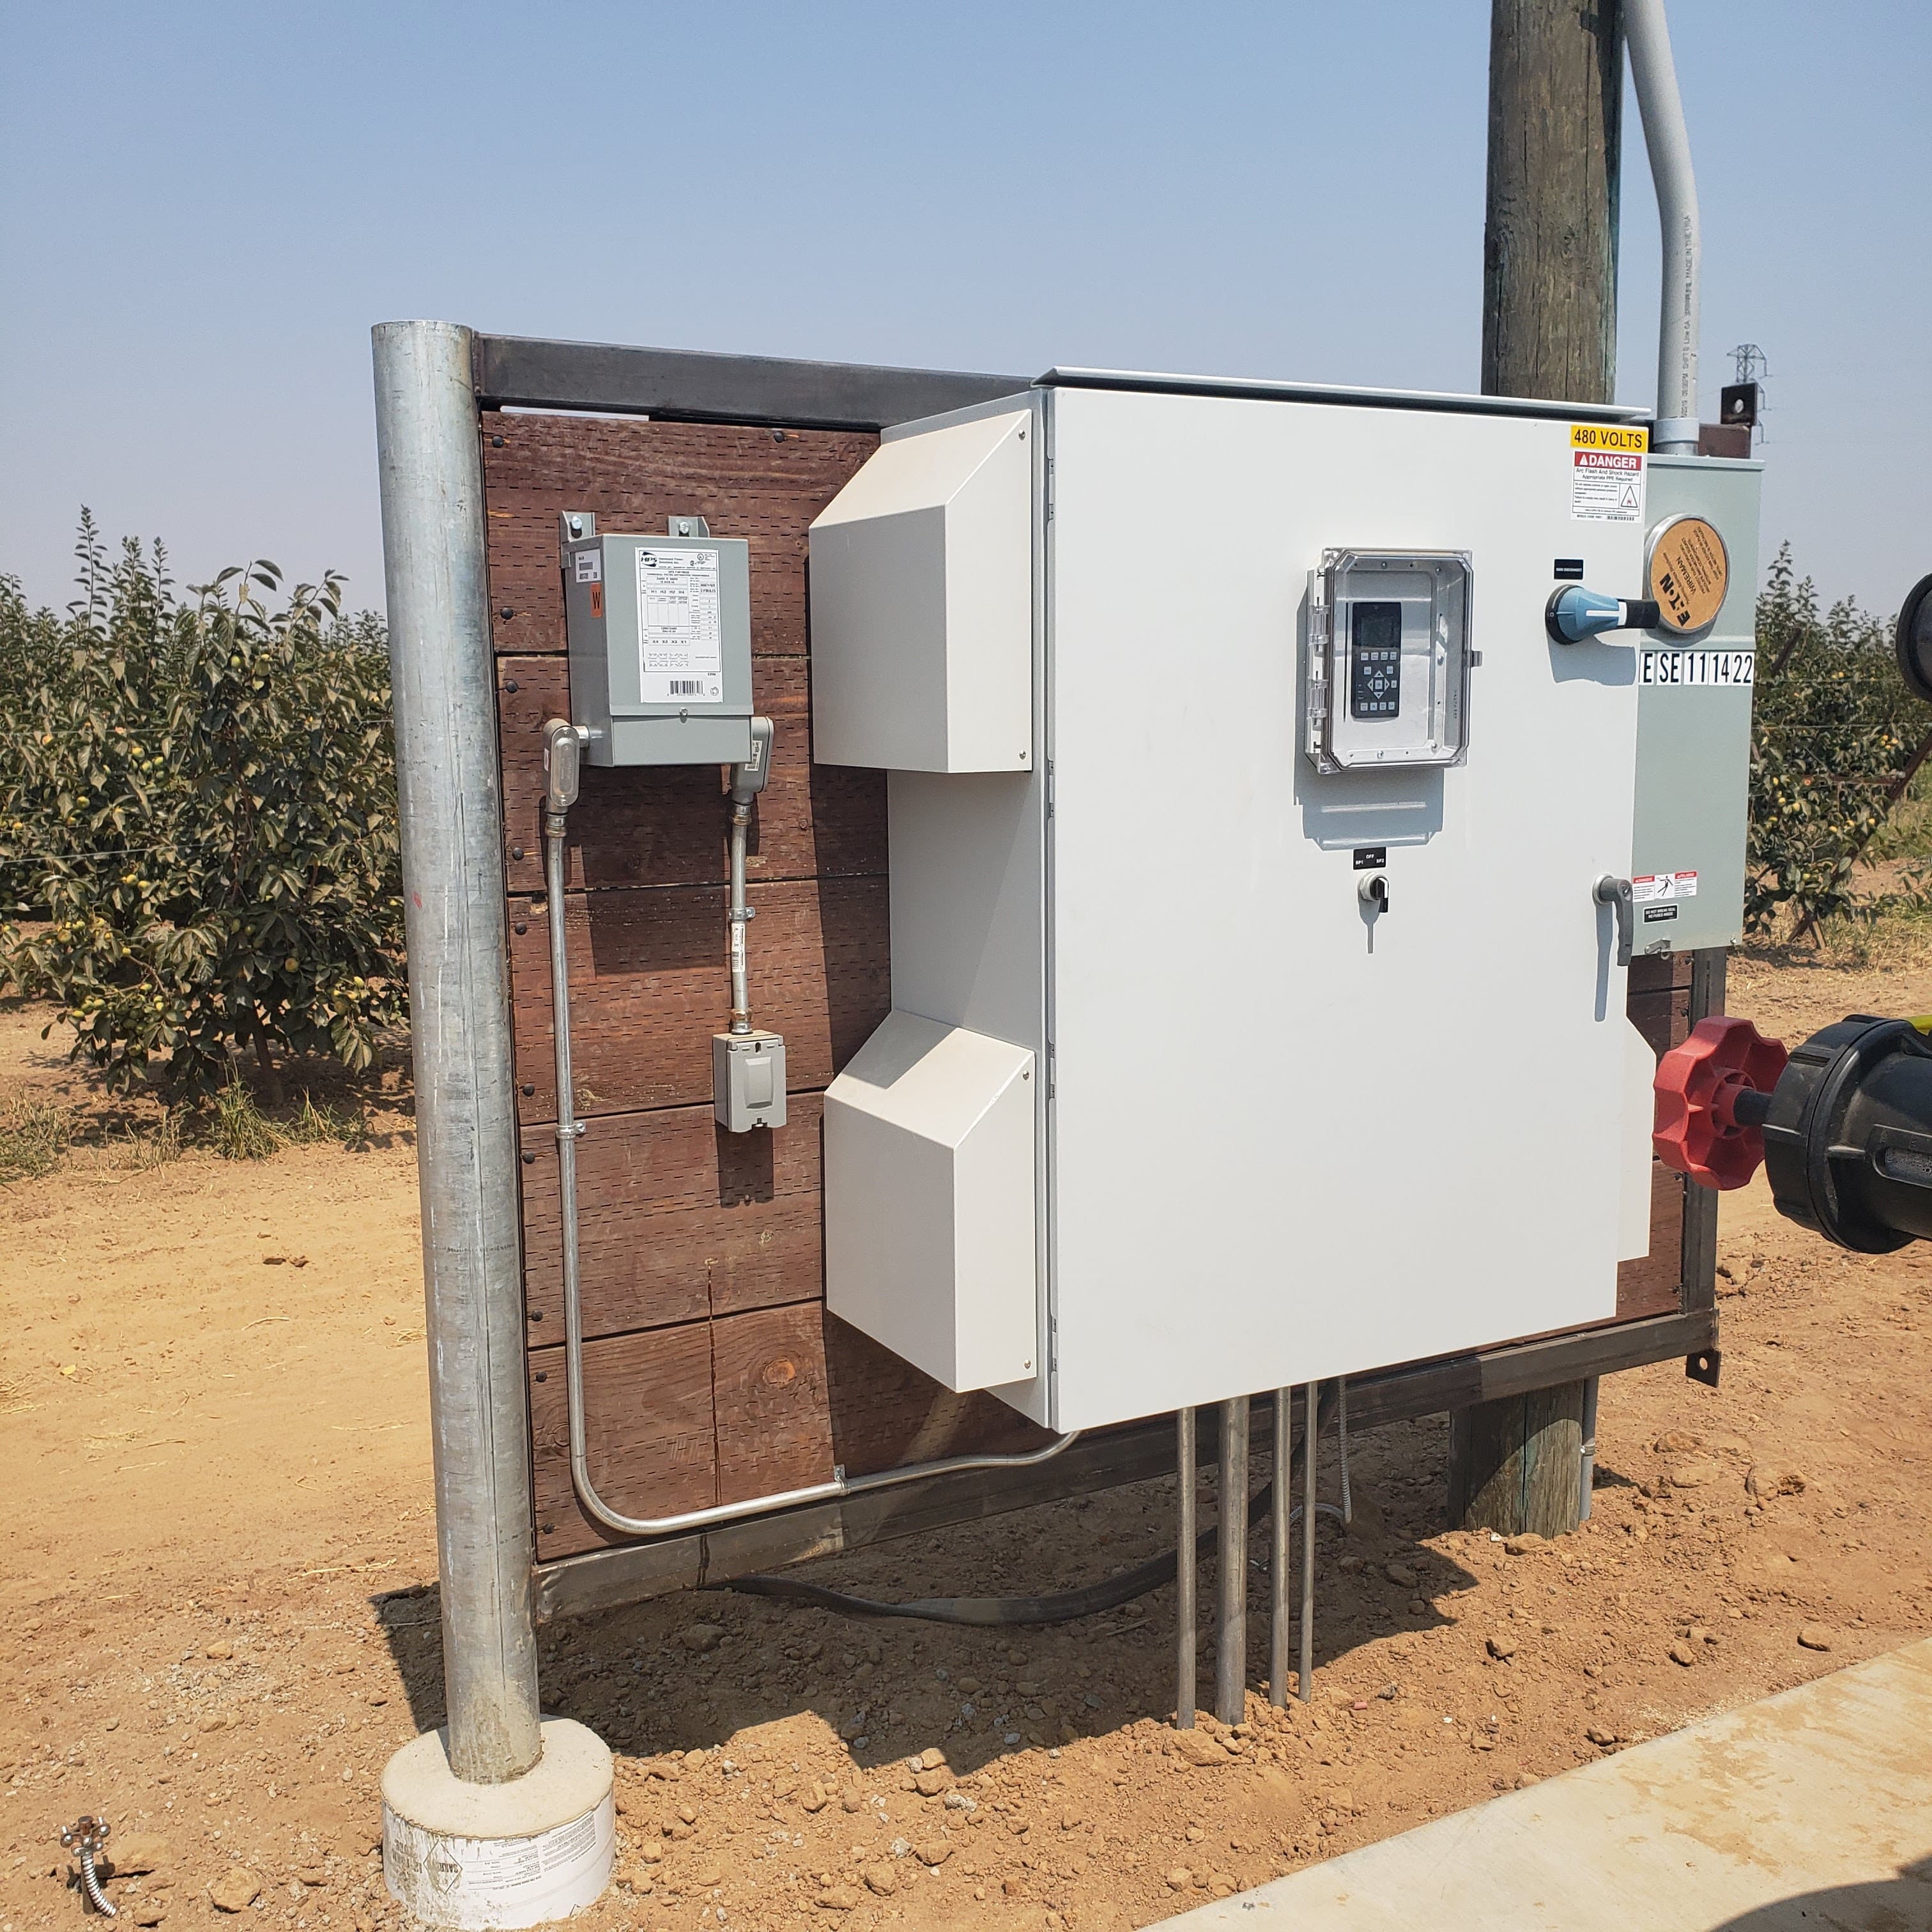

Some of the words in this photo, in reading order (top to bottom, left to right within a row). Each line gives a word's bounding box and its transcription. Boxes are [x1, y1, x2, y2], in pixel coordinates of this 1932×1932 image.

[1574, 429, 1596, 444] 480
[1600, 431, 1642, 448] VOLTS
[1589, 455, 1637, 469] DANGER
[1676, 556, 1696, 594] WIREMAN
[593, 592, 600, 610] W
[1659, 572, 1690, 627] EATON
[1638, 653, 1752, 683] ESE111422
